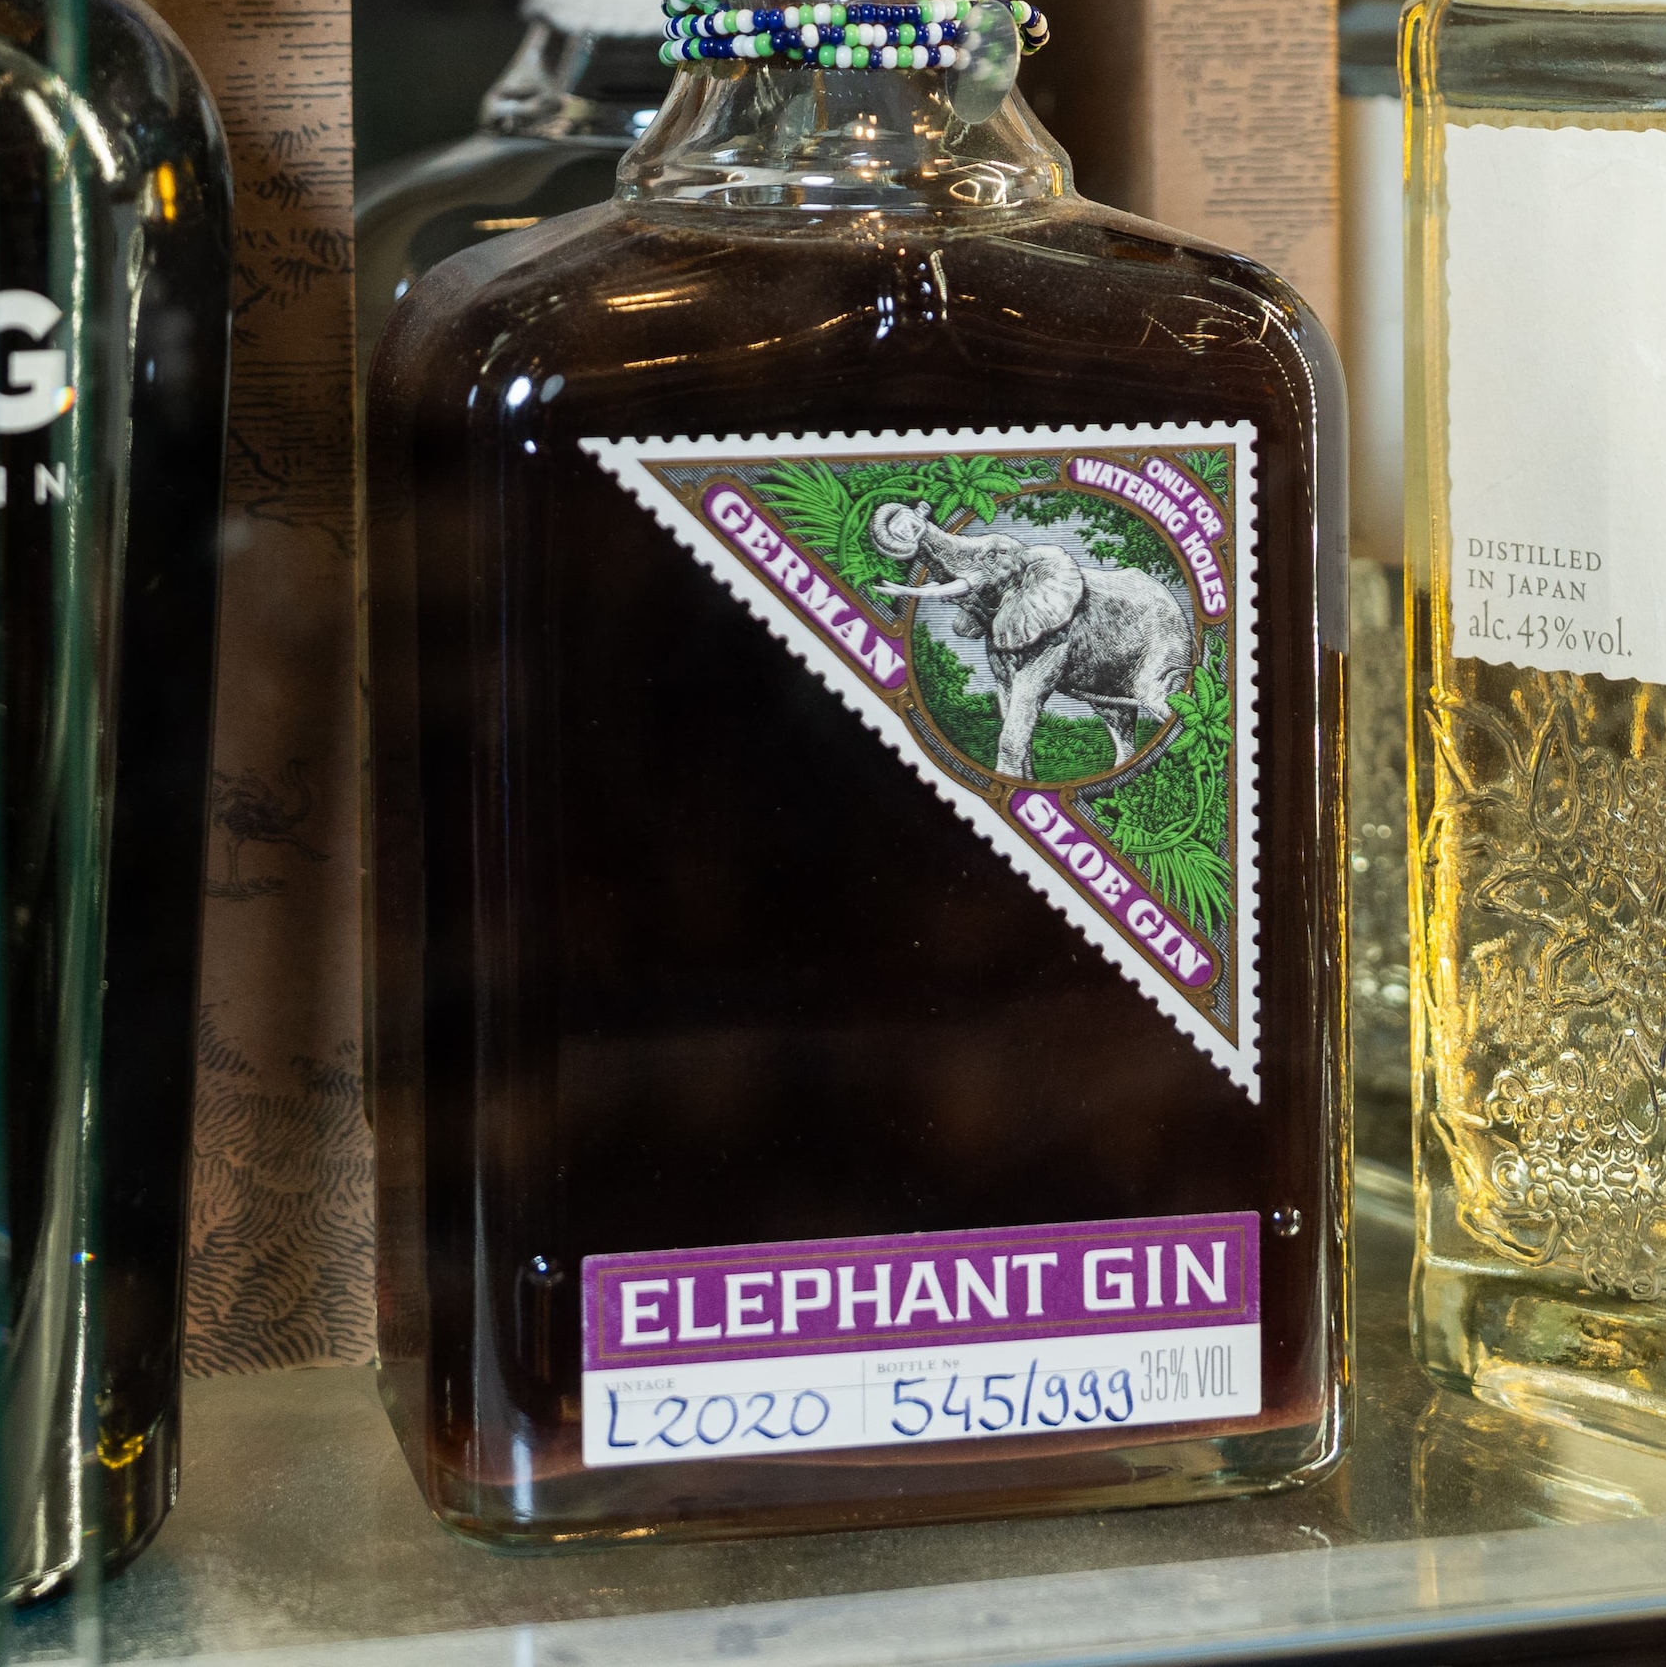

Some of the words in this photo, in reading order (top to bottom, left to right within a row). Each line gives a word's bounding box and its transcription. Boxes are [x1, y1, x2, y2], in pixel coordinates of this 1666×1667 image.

[1146, 459, 1196, 502] ONLY
[1187, 495, 1223, 538] FOR
[1076, 457, 1190, 534] WATERING
[1180, 530, 1228, 614] HOLES
[1468, 538, 1603, 572] DISTILLED
[710, 490, 907, 683] GERMAN
[1467, 568, 1495, 591] IN
[1507, 573, 1587, 603] JAPAN
[1468, 598, 1512, 641] alc.
[1516, 613, 1578, 651] 43%
[1582, 615, 1633, 658] vol.
[1017, 793, 1132, 908] SLOE
[1126, 898, 1210, 981] GIN
[619, 1251, 1059, 1348] ELEPHANT
[1082, 1240, 1229, 1315] GIN
[603, 1377, 677, 1393] VINTAGE
[876, 1360, 937, 1375] BOTTLE
[890, 1357, 1135, 1438] 545/999
[1139, 1345, 1189, 1404] 35%
[1194, 1343, 1239, 1398] VOL
